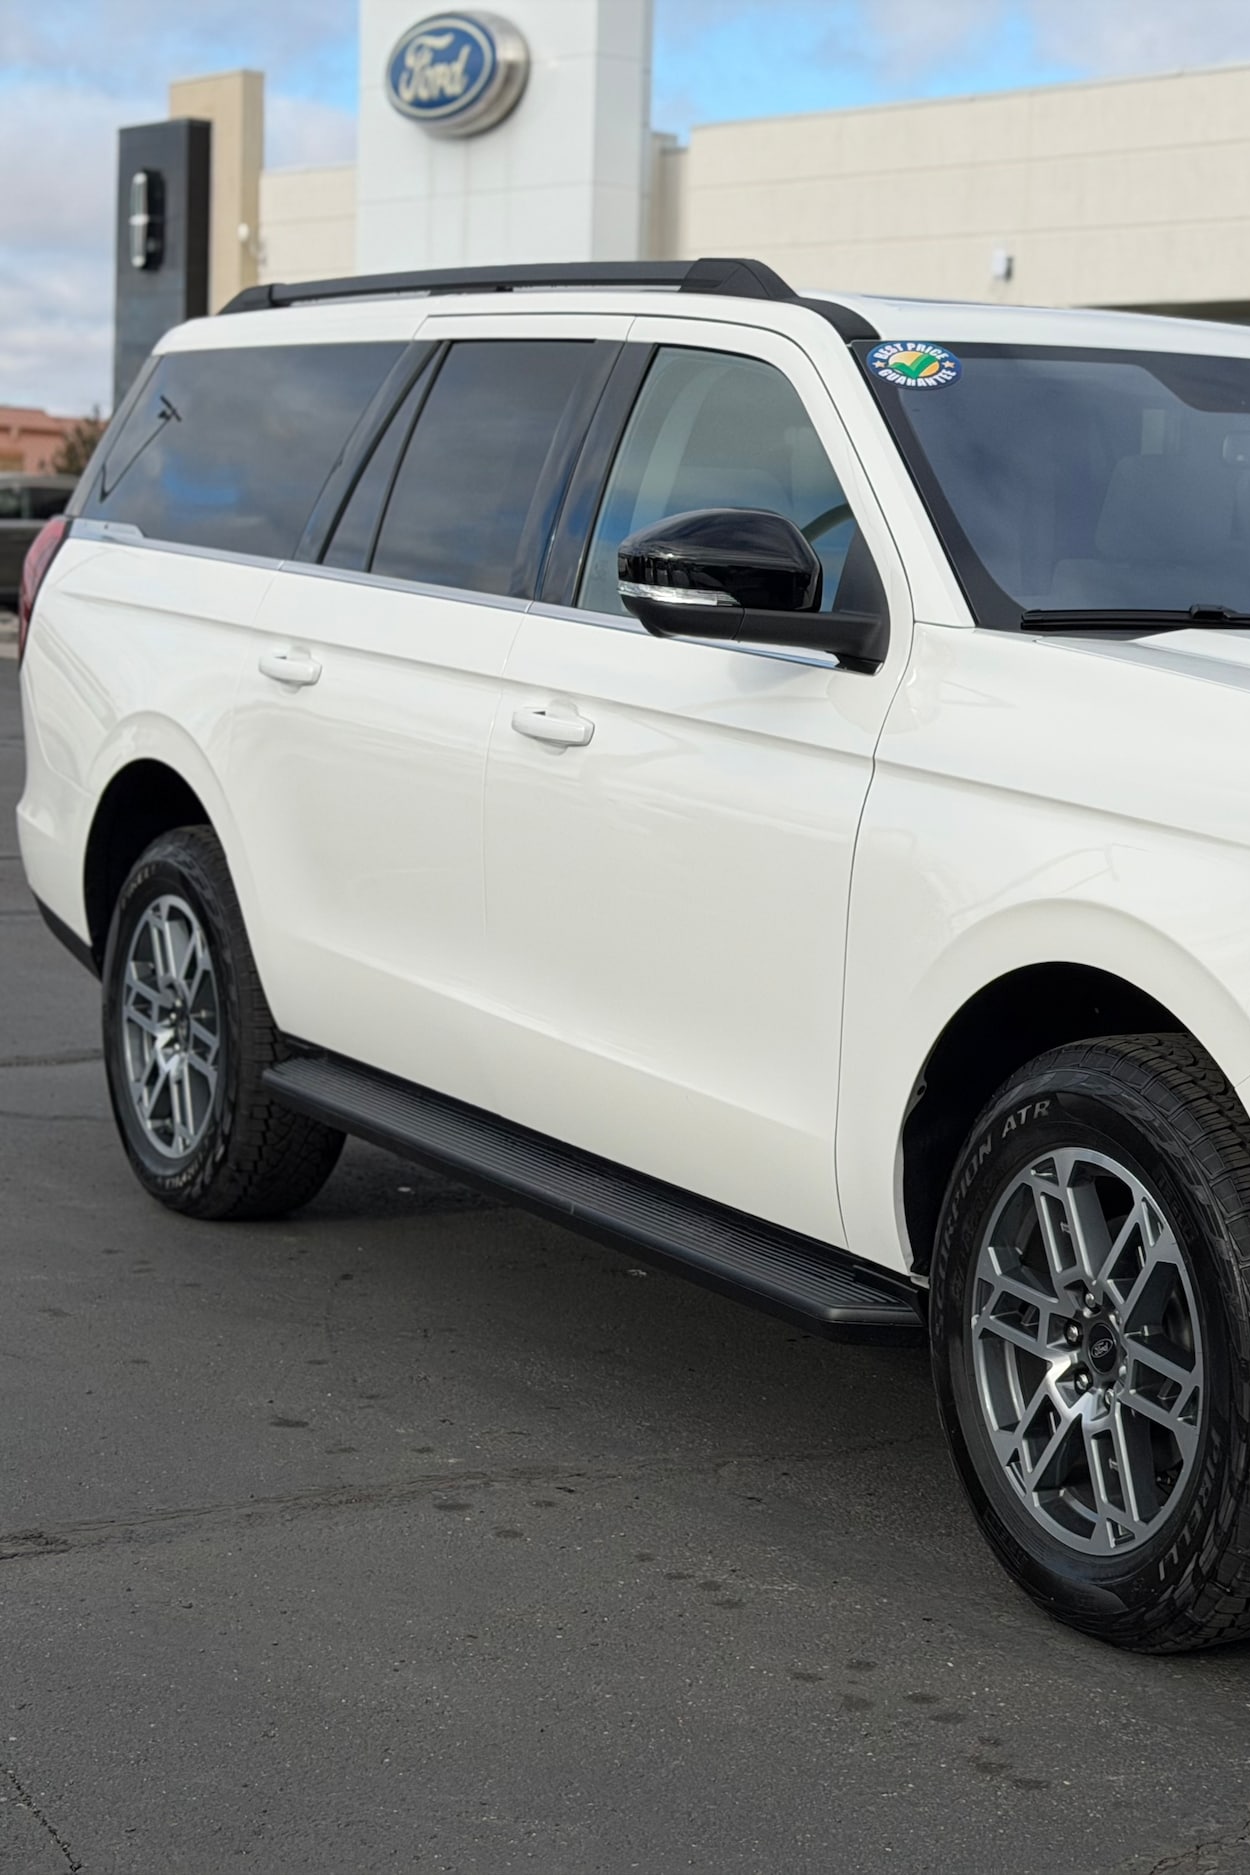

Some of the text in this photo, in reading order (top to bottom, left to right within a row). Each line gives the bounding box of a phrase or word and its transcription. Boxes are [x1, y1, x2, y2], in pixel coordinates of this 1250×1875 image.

[399, 33, 471, 103] Ford
[873, 342, 949, 360] BEST PRICE
[878, 368, 957, 387] GUARANTEE
[1001, 1099, 1051, 1138] ATR
[1158, 1423, 1223, 1582] PIRELLI
